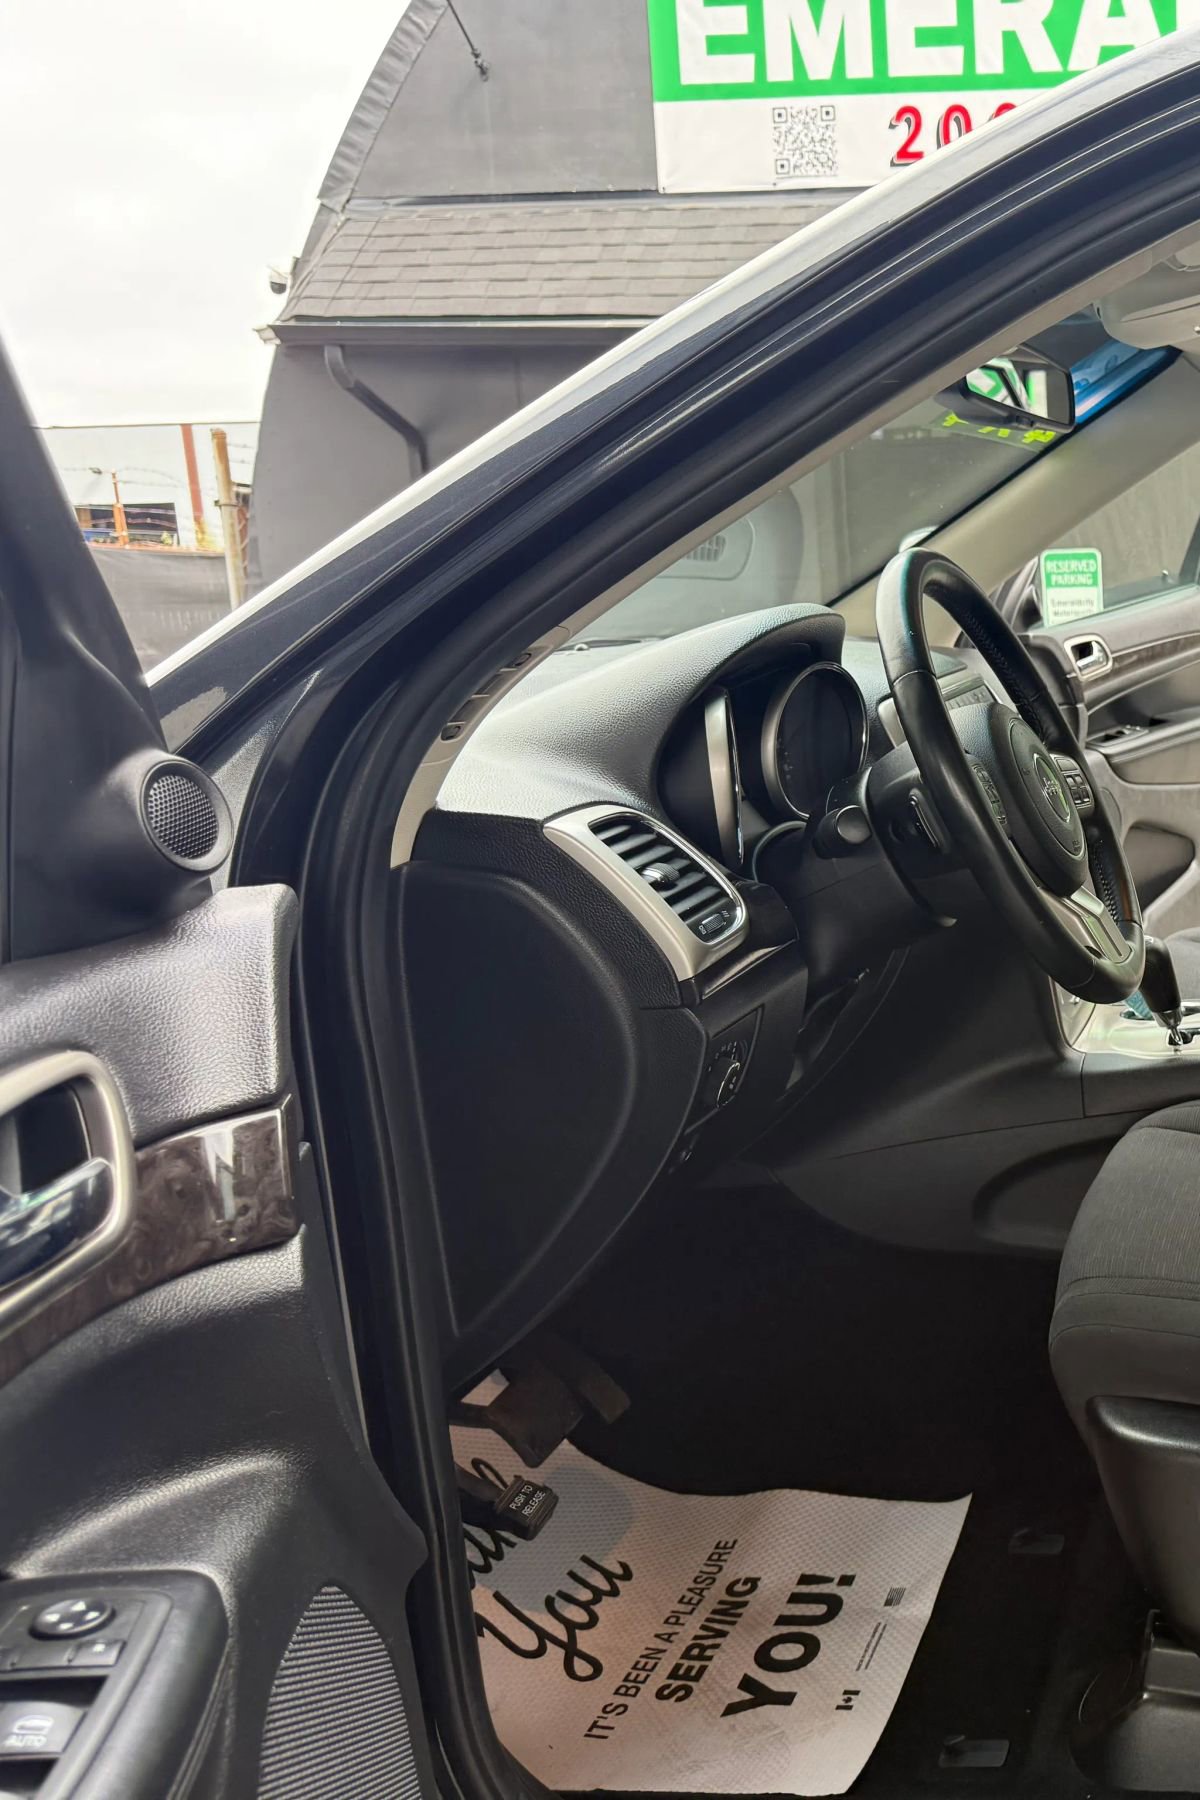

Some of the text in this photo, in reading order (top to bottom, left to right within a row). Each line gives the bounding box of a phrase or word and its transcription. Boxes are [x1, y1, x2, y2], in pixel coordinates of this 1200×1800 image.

[888, 103, 1017, 167] 20
[1045, 558, 1097, 573] RESERVED
[1051, 573, 1093, 586] PARKING
[509, 1484, 533, 1511] PUSH TO
[521, 1490, 546, 1517] RELEASE
[475, 1555, 634, 1683] You
[583, 1538, 738, 1740] IT'S BEEN A PLEASURE
[655, 1576, 762, 1703] SERVING
[720, 1573, 857, 1718] YOU!
[4, 1732, 48, 1748] AUTO
